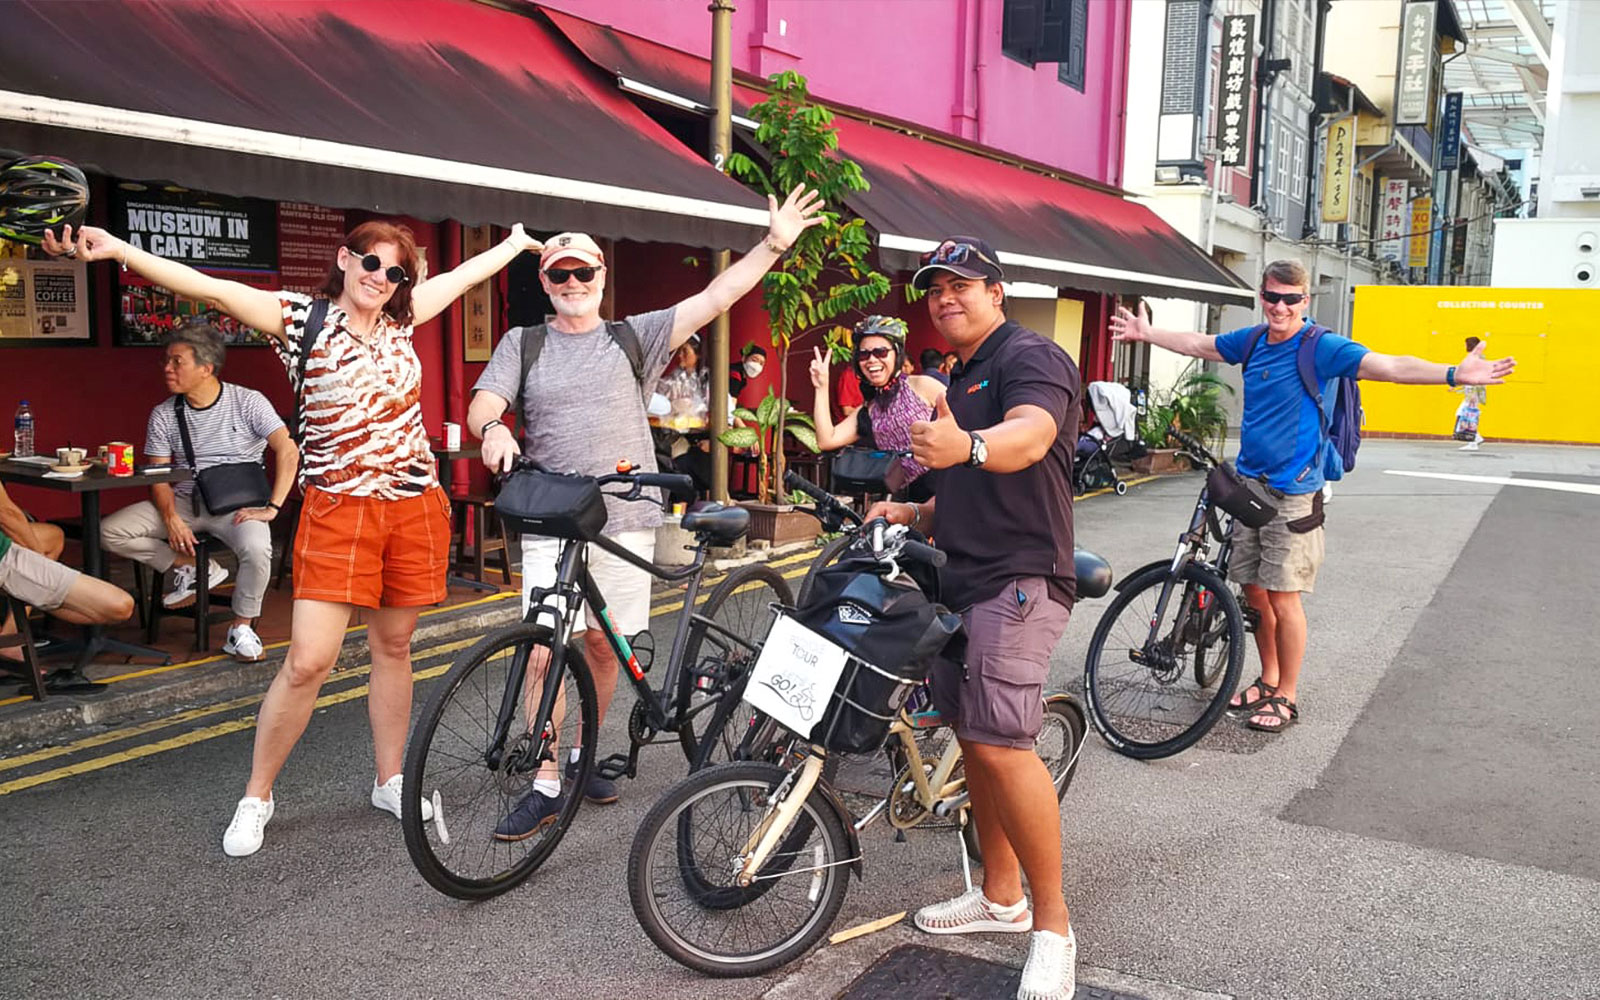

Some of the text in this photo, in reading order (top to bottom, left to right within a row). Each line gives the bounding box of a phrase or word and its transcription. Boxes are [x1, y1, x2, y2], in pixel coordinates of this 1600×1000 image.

[714, 153, 724, 172] 2
[127, 209, 249, 240] MUSEUM IN
[129, 232, 206, 259] A CAFE
[36, 291, 74, 302] COFFEE
[1437, 301, 1544, 309] COLLECTION COUNTER
[792, 643, 819, 668] TOUR
[770, 674, 797, 695] GO!
